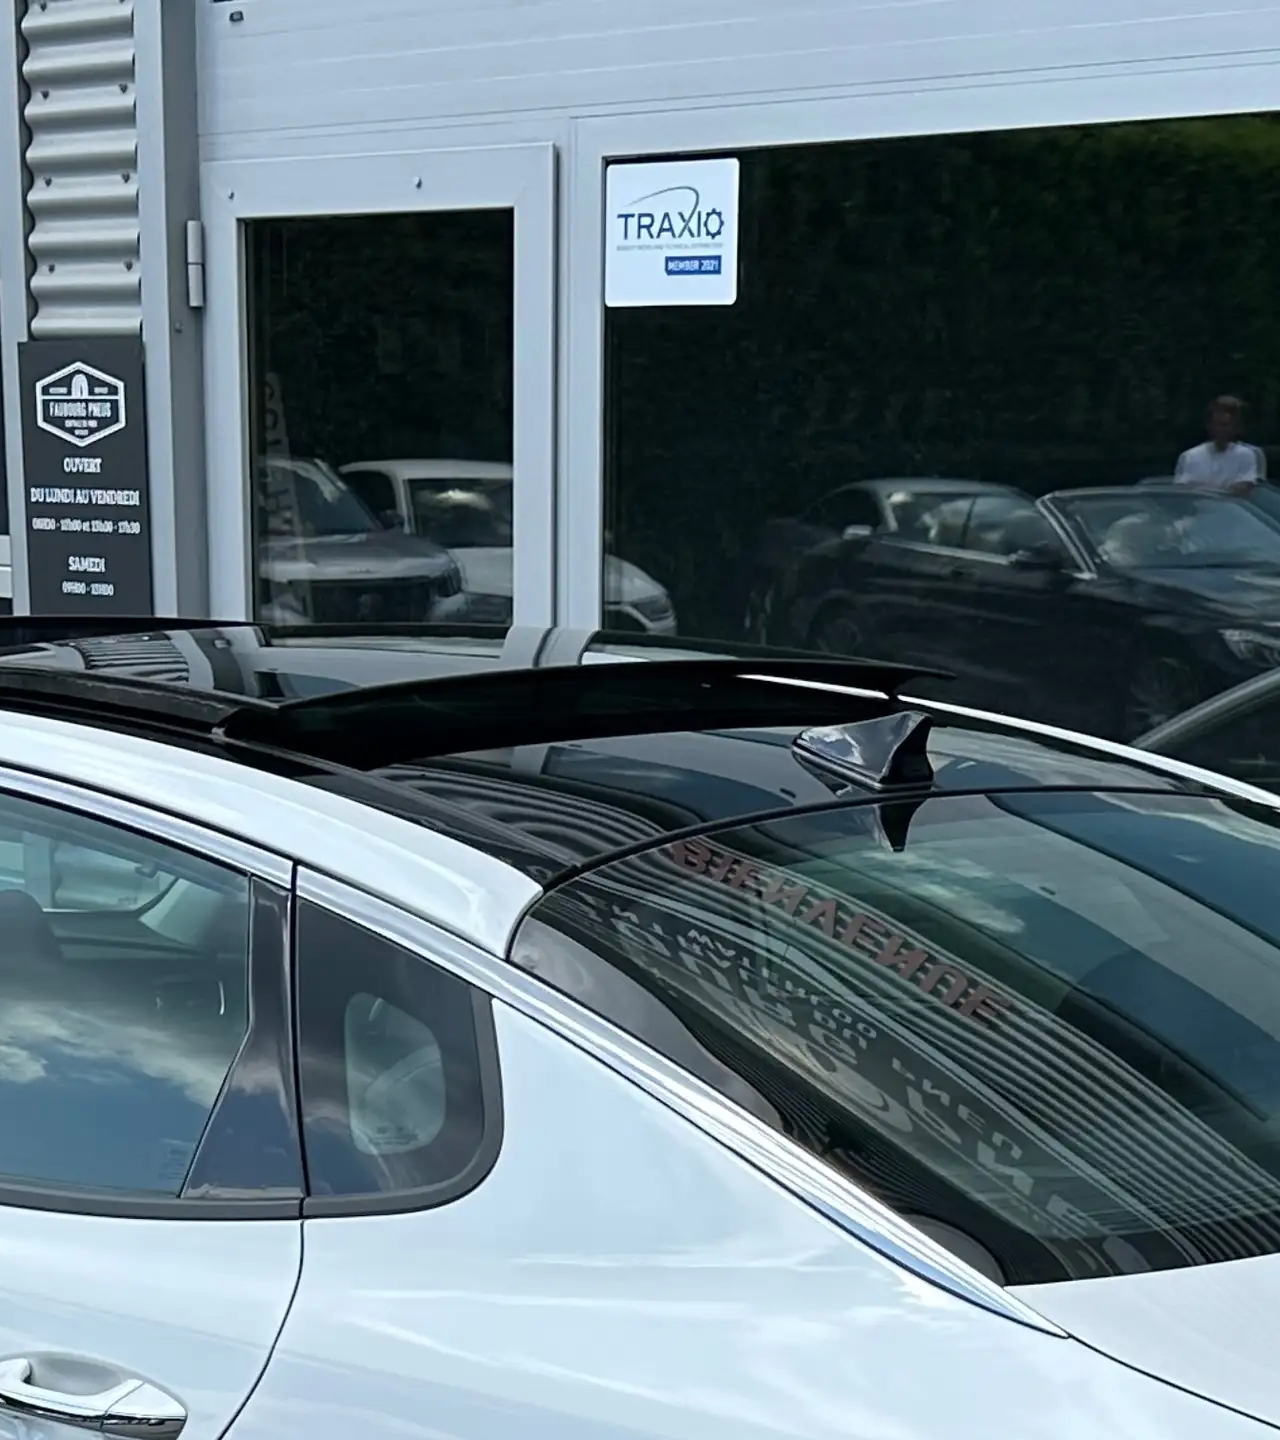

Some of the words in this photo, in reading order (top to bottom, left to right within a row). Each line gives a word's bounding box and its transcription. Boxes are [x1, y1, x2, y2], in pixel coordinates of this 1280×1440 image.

[617, 208, 724, 240] TRAXIO
[667, 260, 699, 272] MEMBER
[63, 457, 102, 473] OUVERT
[30, 487, 44, 502] DU
[45, 488, 74, 504] LUNDI
[75, 489, 90, 504] AU
[90, 490, 140, 505] VENDREDI
[68, 556, 106, 573] SAMEDI
